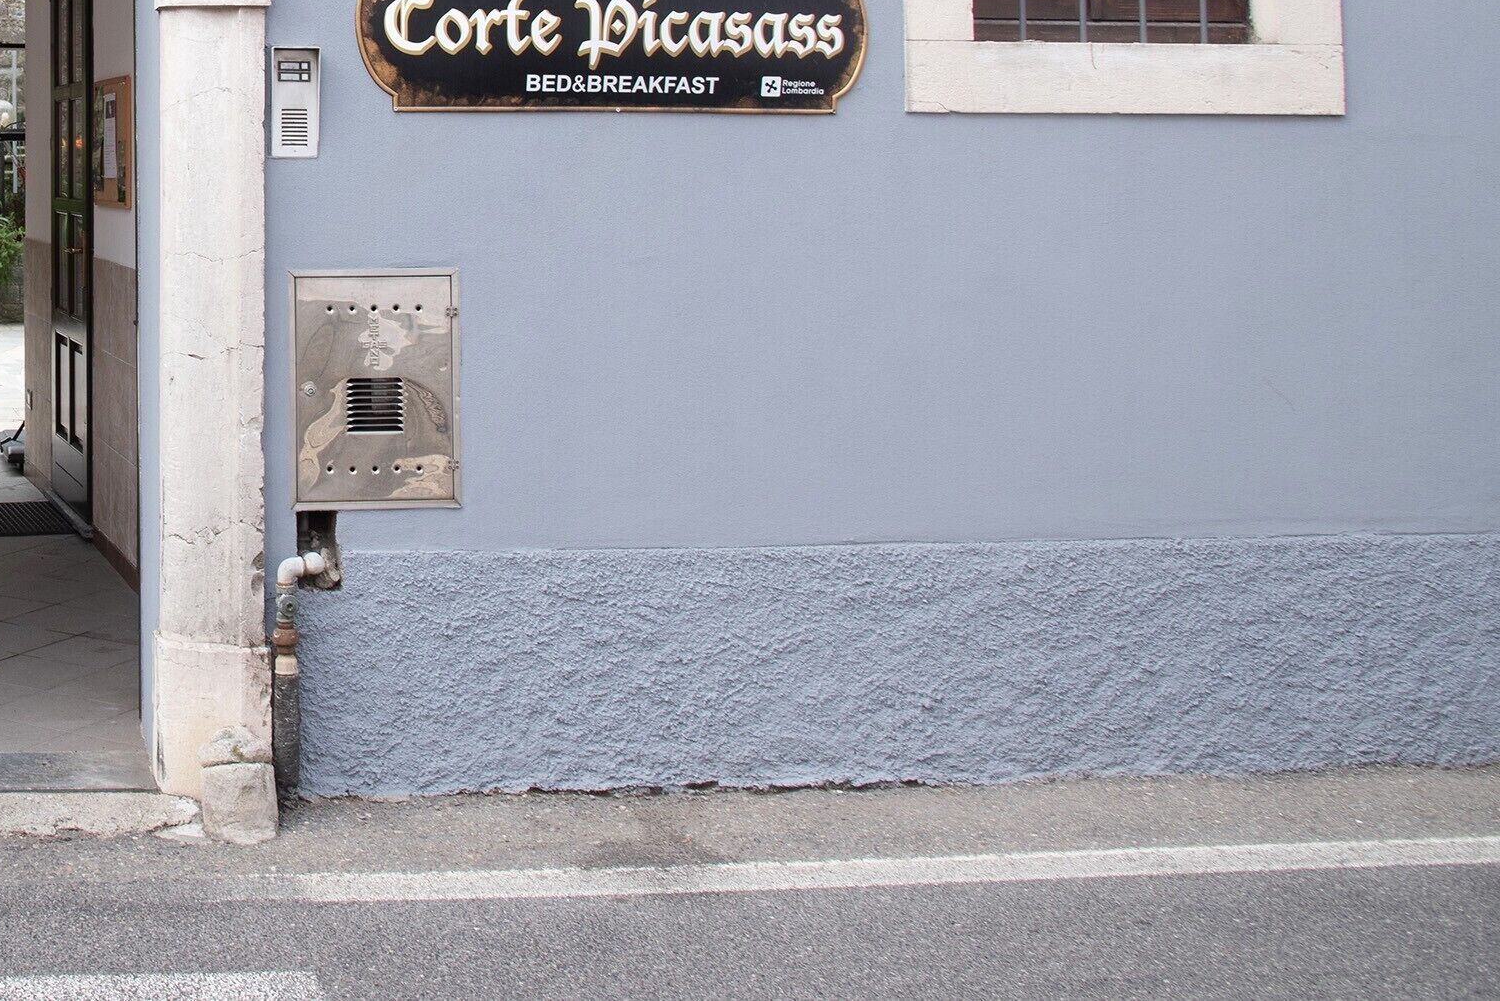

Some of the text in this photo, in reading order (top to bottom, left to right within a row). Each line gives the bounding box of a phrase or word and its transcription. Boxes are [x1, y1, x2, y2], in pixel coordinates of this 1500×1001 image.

[525, 73, 720, 94] BED&BREAKFAST
[782, 79, 816, 89] Regione
[781, 87, 825, 95] Lombardia
